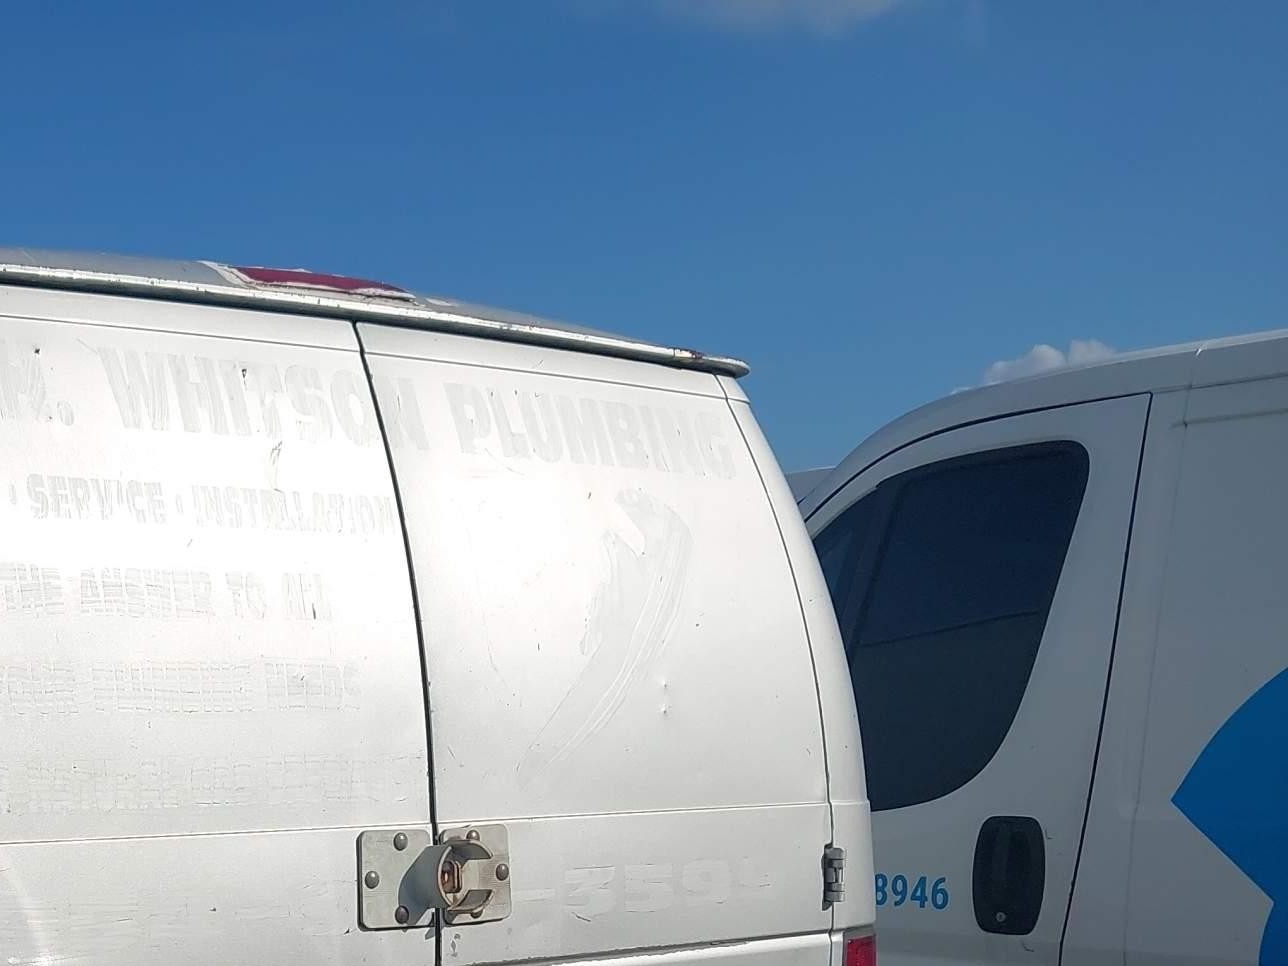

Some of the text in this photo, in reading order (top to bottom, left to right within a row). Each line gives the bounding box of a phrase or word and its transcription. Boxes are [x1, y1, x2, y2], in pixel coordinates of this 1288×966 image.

[96, 346, 430, 451] WHITSON
[443, 381, 739, 479] PLUMBING
[26, 472, 168, 527] SERVICE
[191, 484, 398, 536] INSTALLATION
[874, 872, 950, 910] 8946
